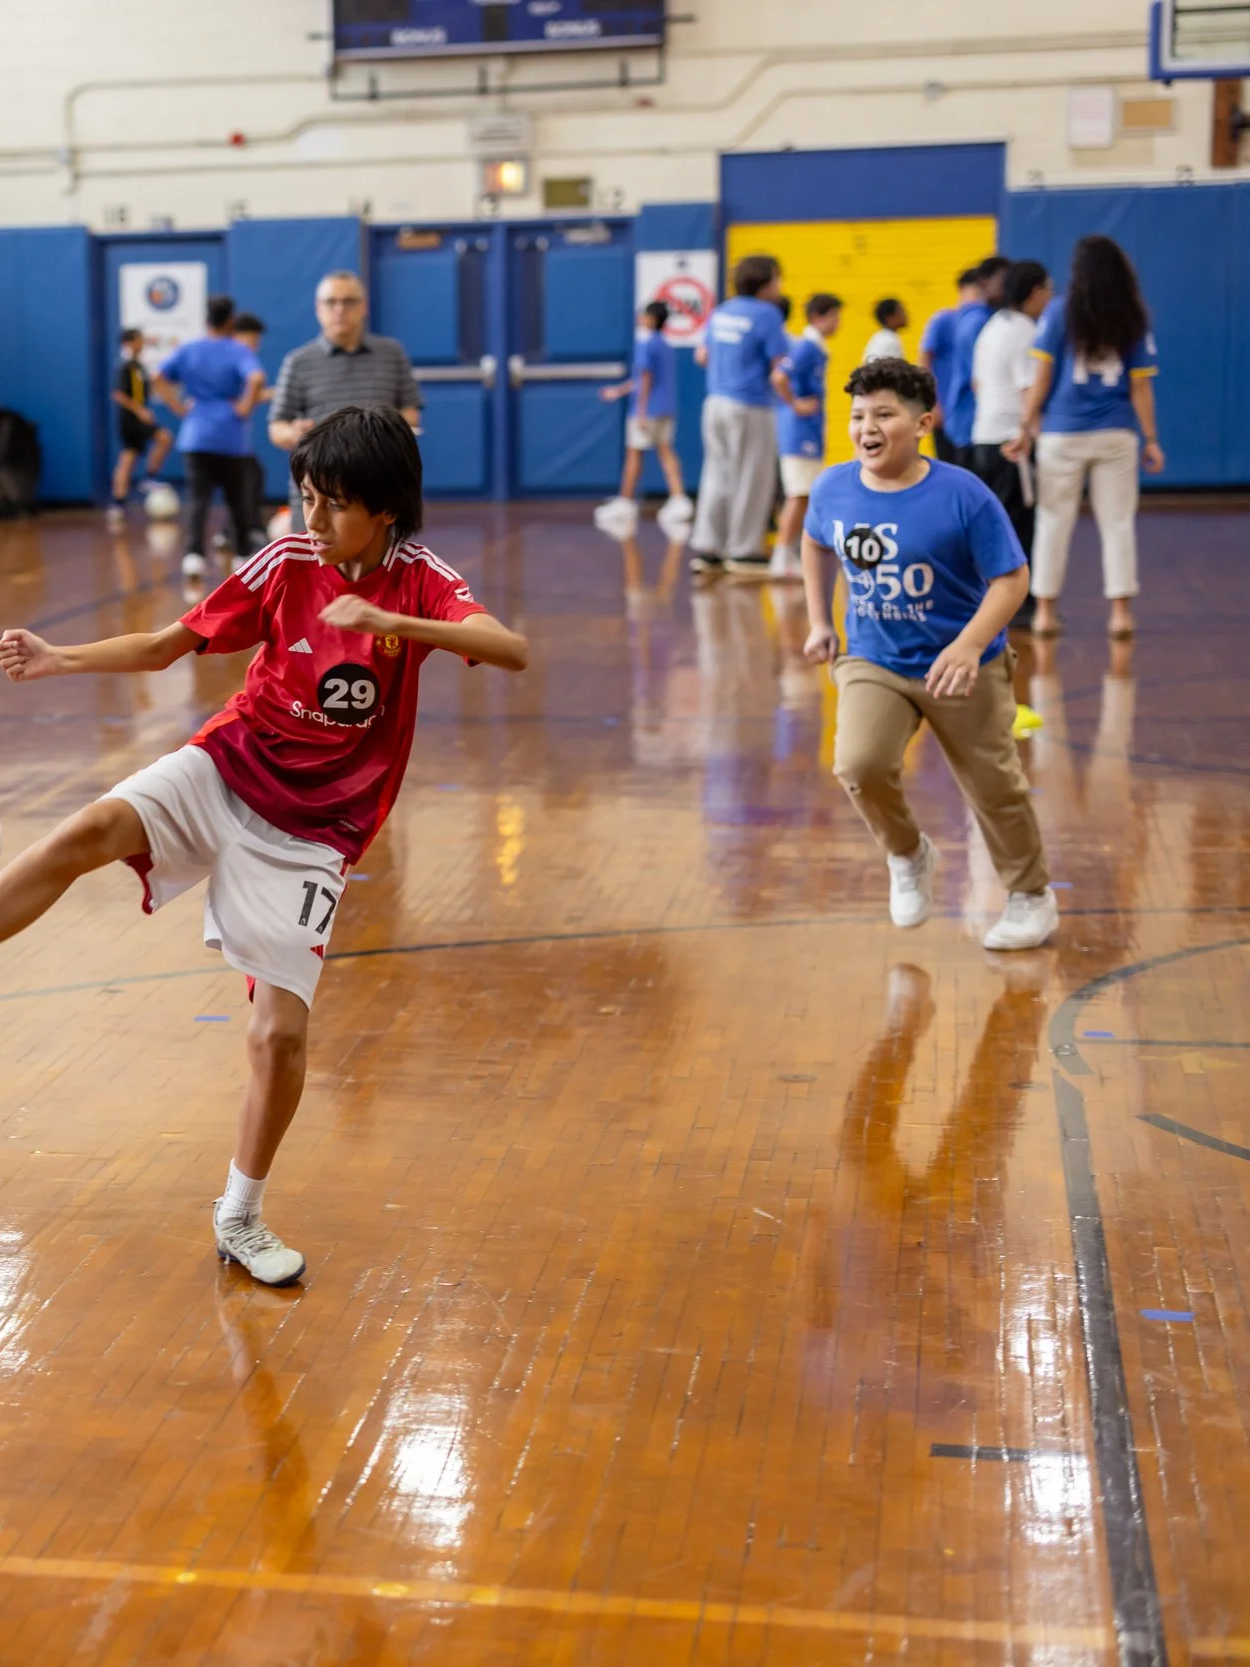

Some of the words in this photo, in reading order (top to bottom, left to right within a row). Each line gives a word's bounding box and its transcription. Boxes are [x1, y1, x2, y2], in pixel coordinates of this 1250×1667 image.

[846, 536, 881, 562] 10
[323, 678, 376, 710] 29
[298, 879, 337, 935] 17
